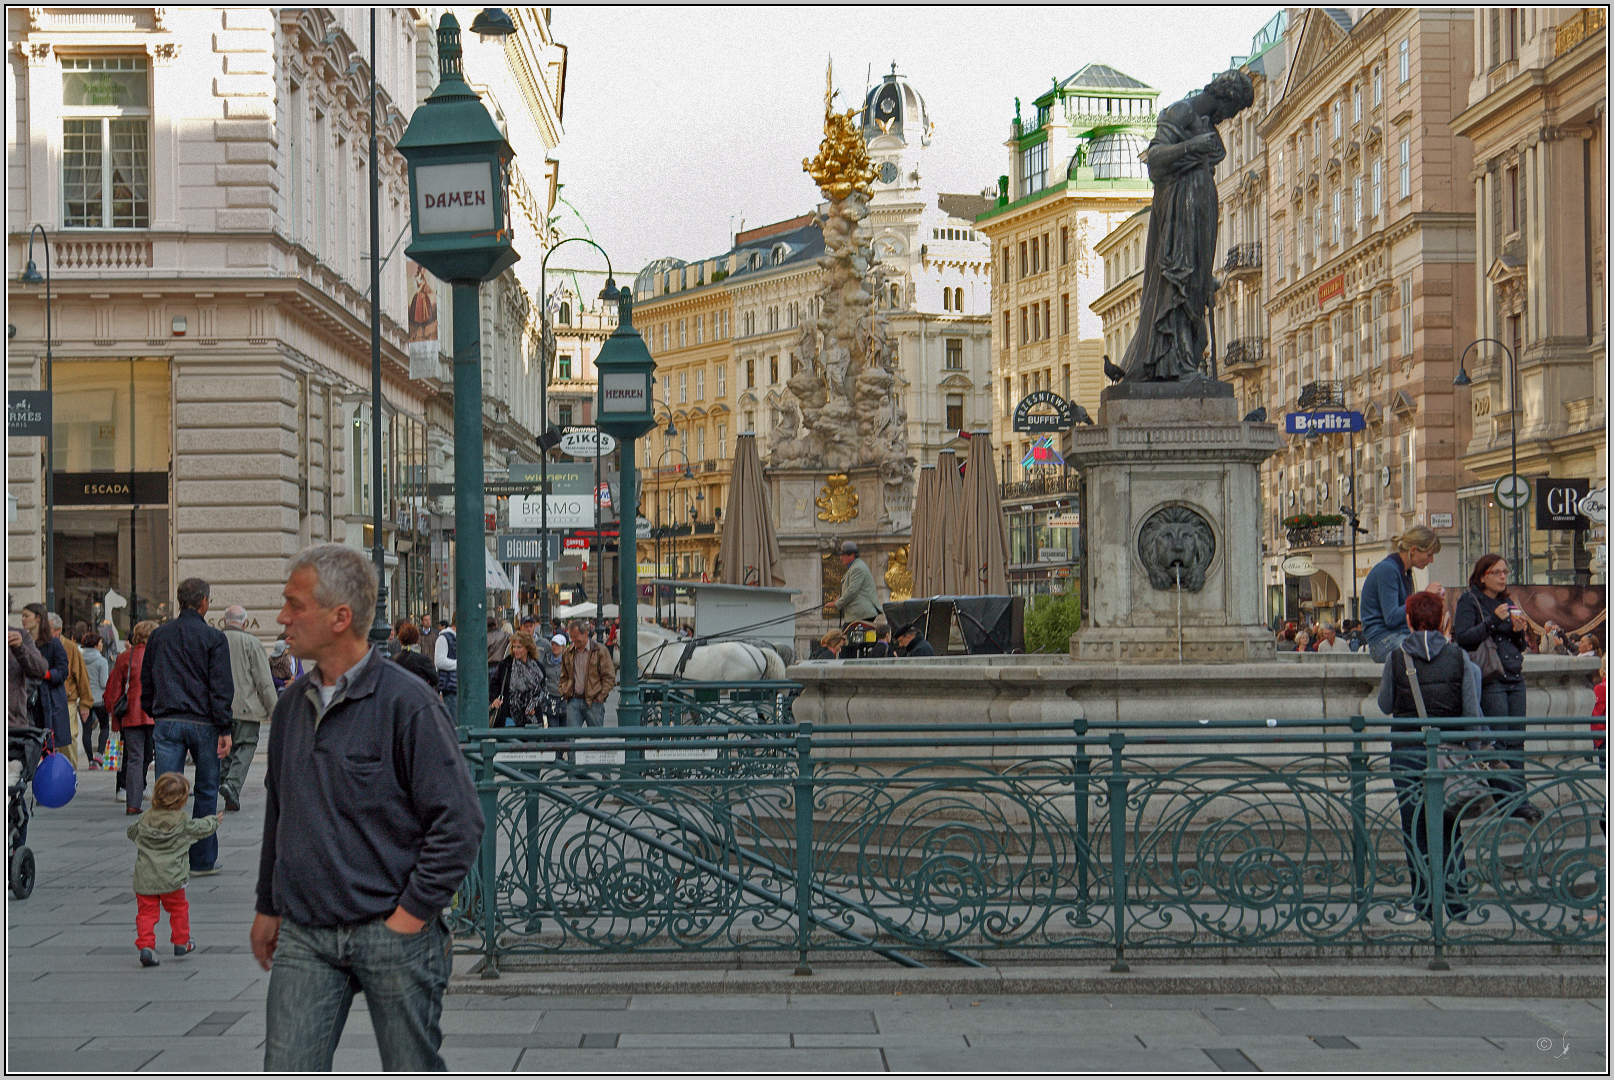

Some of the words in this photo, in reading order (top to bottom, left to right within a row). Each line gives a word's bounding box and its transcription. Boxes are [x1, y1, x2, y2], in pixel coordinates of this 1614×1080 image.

[425, 190, 486, 209] DAMEN
[605, 389, 644, 399] HERREN
[1027, 416, 1060, 424] BUFFET
[1295, 414, 1350, 430] Berlitz
[566, 434, 609, 446] ZIKOS
[84, 485, 130, 494] ESCADA
[1547, 487, 1580, 515] GR
[522, 502, 581, 515] BRAMO
